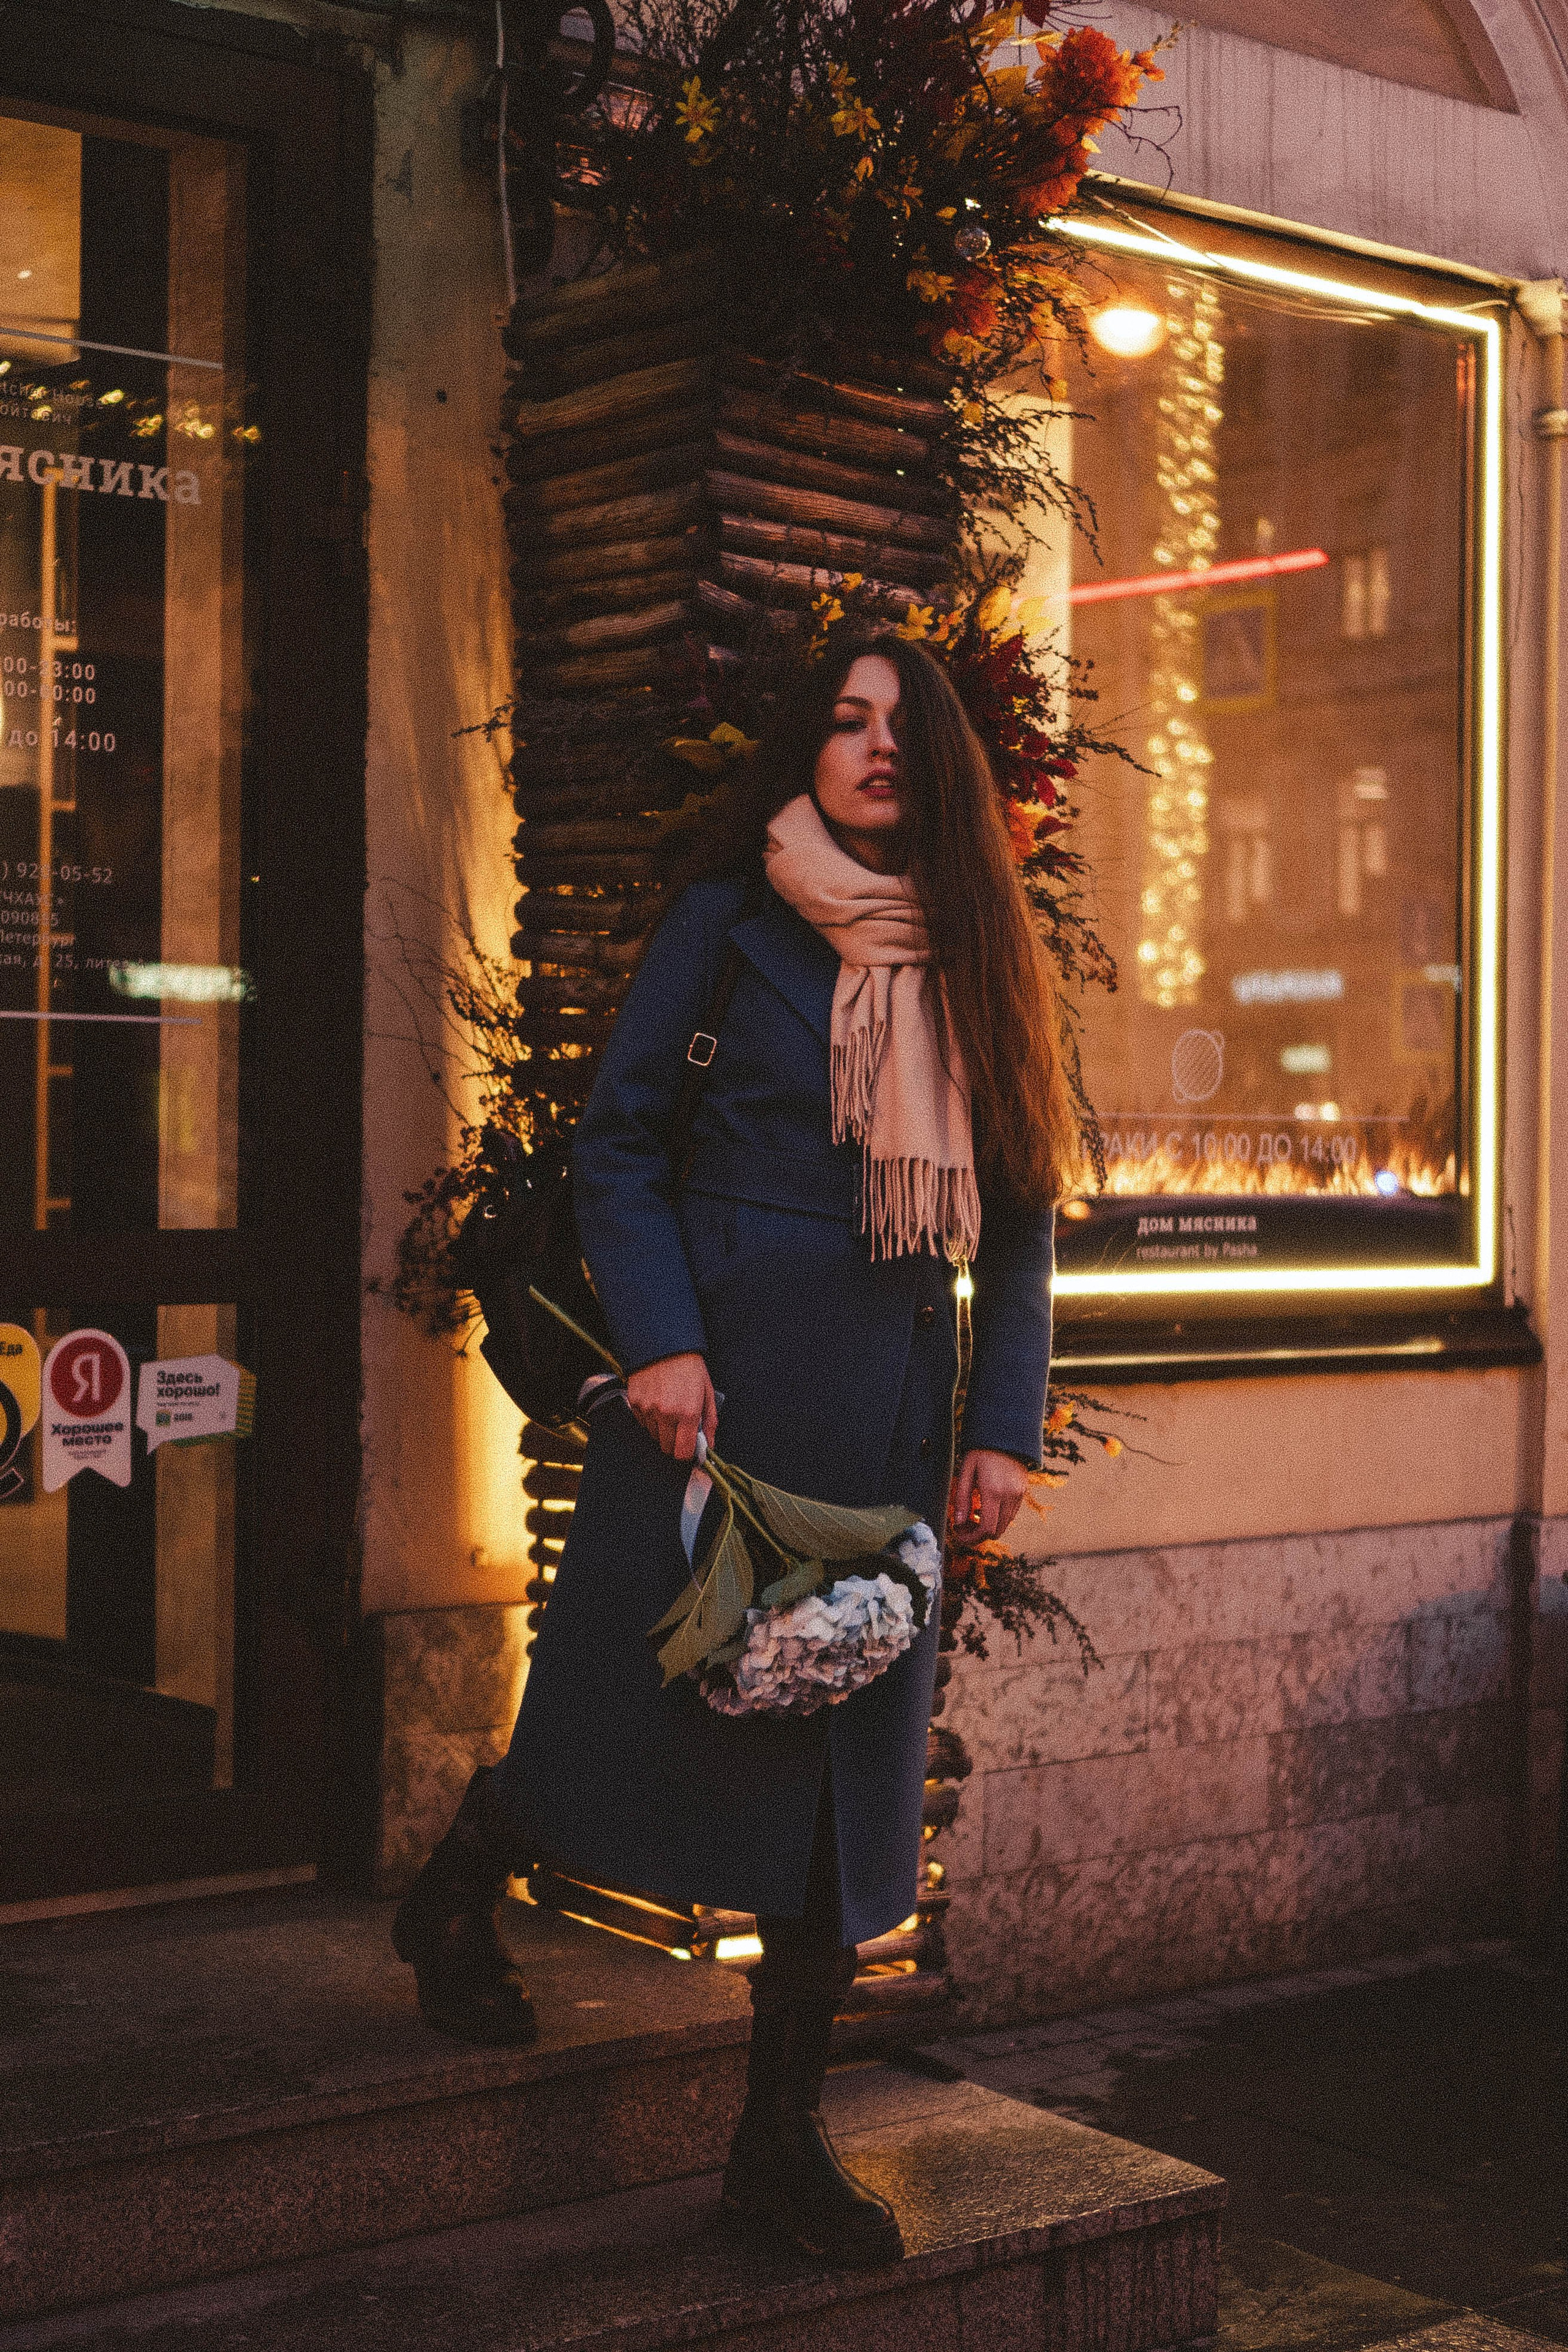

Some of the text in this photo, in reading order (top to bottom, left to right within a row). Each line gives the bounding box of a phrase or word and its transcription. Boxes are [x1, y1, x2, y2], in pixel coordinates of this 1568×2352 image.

[8, 729, 116, 752] до 14:00
[1164, 1131, 1183, 1161] С
[1256, 1133, 1293, 1167] ДО
[1300, 1134, 1357, 1164] 14:00
[71, 1352, 101, 1403] Я
[157, 1370, 203, 1386] Здесь
[157, 1382, 221, 1400] хорошо!
[51, 1422, 124, 1436] Хорошее
[62, 1434, 113, 1447] место
